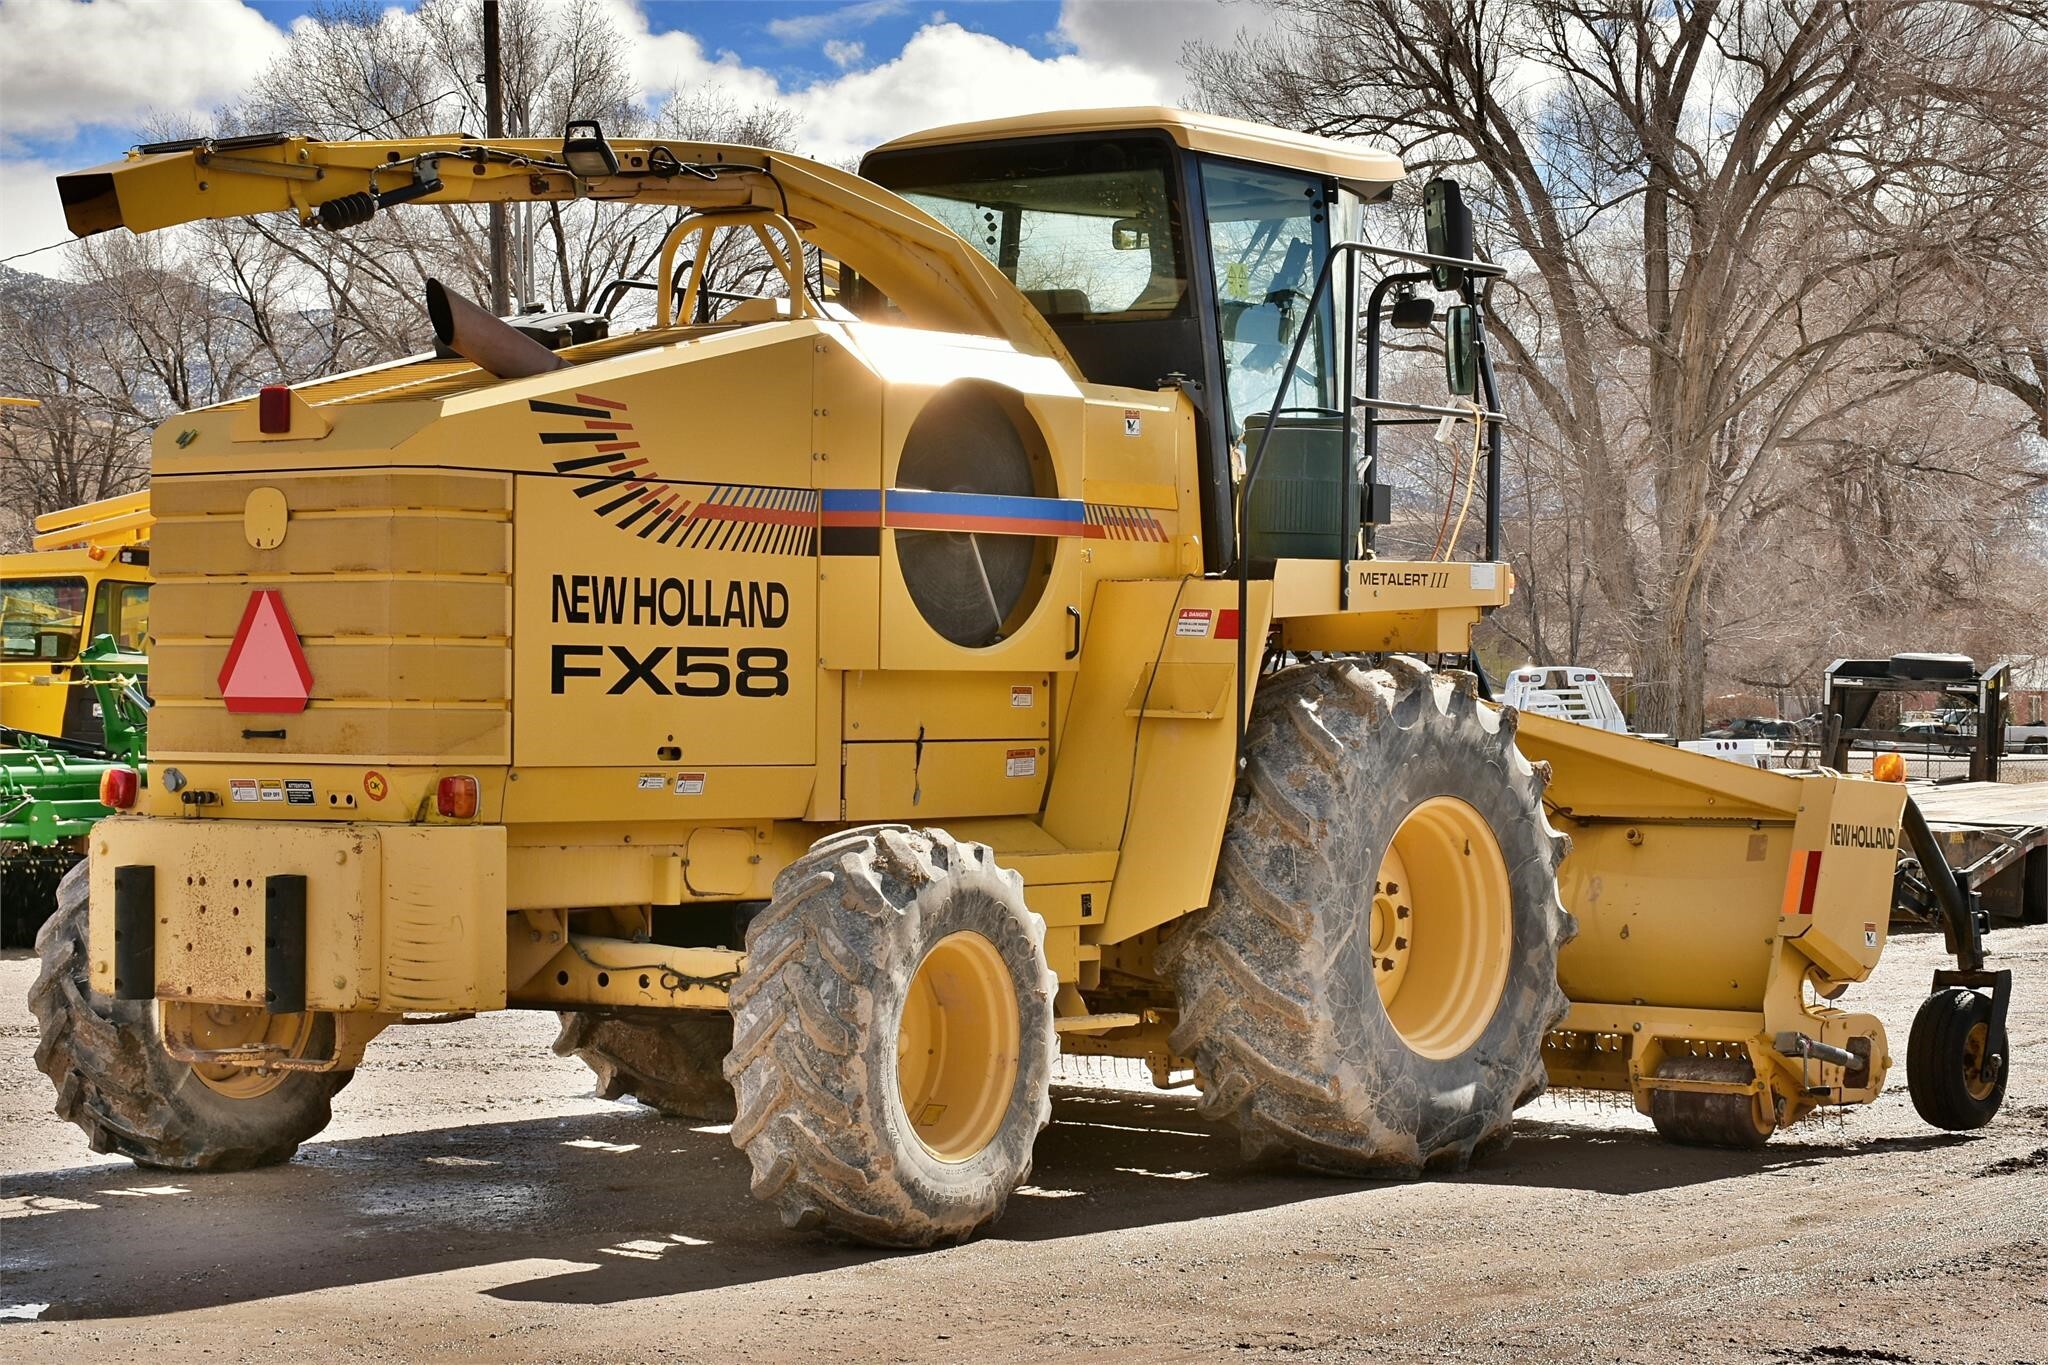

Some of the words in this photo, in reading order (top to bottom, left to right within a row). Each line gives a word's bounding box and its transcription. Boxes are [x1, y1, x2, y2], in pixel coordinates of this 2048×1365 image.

[1359, 572, 1428, 586] METALERT
[1430, 572, 1450, 588] III
[552, 574, 627, 624] NEW
[633, 577, 789, 628] HOLLAND
[551, 644, 789, 698] FX58
[370, 781, 381, 791] OK
[1830, 823, 1850, 847] NEW
[1851, 824, 1896, 849] HOLLAND
